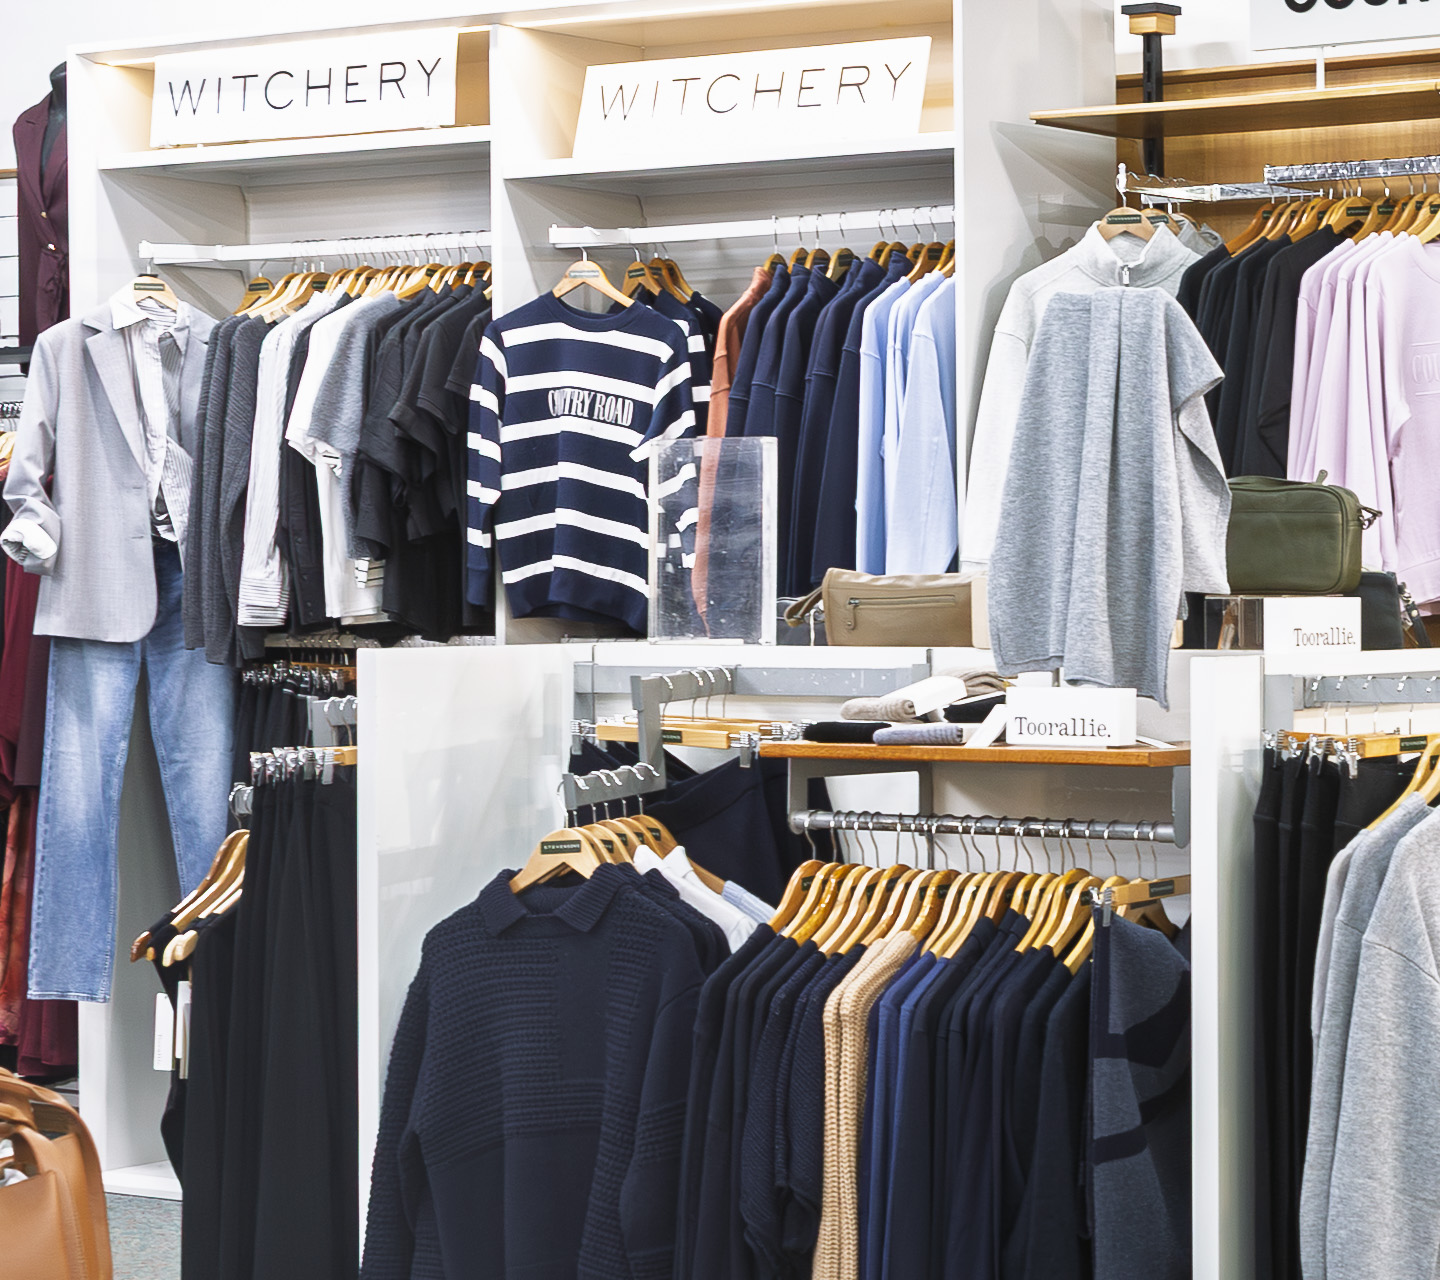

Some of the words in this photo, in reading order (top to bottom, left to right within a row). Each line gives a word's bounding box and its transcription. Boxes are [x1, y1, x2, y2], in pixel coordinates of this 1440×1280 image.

[168, 57, 442, 118] WITCHERY
[600, 61, 912, 122] WITCHERY
[592, 392, 634, 426] ROAD
[1293, 627, 1356, 647] Toorallie.
[1014, 716, 1111, 738] Toorallie.
